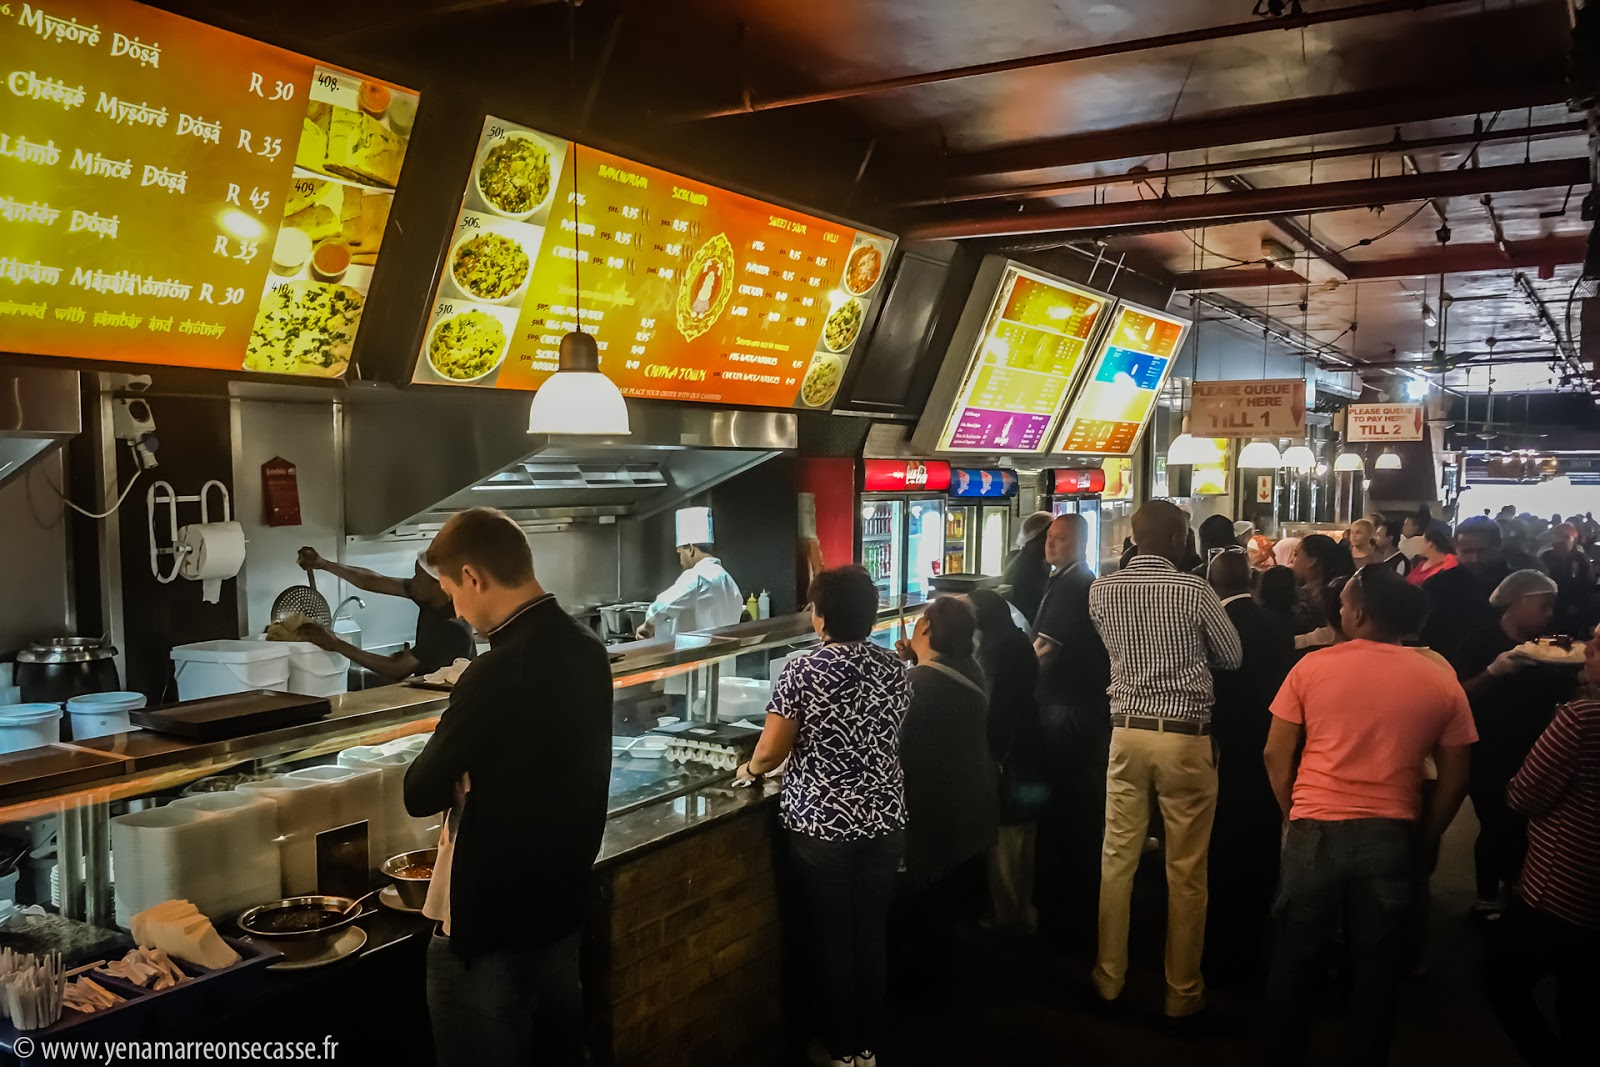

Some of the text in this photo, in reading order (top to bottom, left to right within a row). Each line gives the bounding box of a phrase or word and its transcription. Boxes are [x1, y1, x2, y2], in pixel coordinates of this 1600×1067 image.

[0, 3, 294, 101] 6. Mysore Dosa R 30
[317, 72, 340, 92] 408.
[8, 71, 282, 162] Cheese Mysore Dosa R 35
[0, 133, 270, 214] Lamb Mince Dosa R 45
[295, 179, 316, 198] 409.
[460, 217, 480, 229] 506.
[69, 210, 120, 239] Dosa
[213, 235, 228, 257] R
[233, 239, 258, 264] 35
[199, 283, 213, 304] R
[218, 288, 245, 305] 30
[55, 306, 87, 324] with
[93, 311, 143, 329] sambar
[148, 316, 174, 332] and
[179, 318, 226, 339] chutney
[644, 364, 708, 382] CHINA TOWN
[1193, 384, 1290, 396] PLEASE QUEUE
[1247, 396, 1282, 407] HERE
[1383, 407, 1413, 415] QUEUE
[1208, 411, 1270, 428] TILL 1
[1359, 424, 1402, 435] TILL 2
